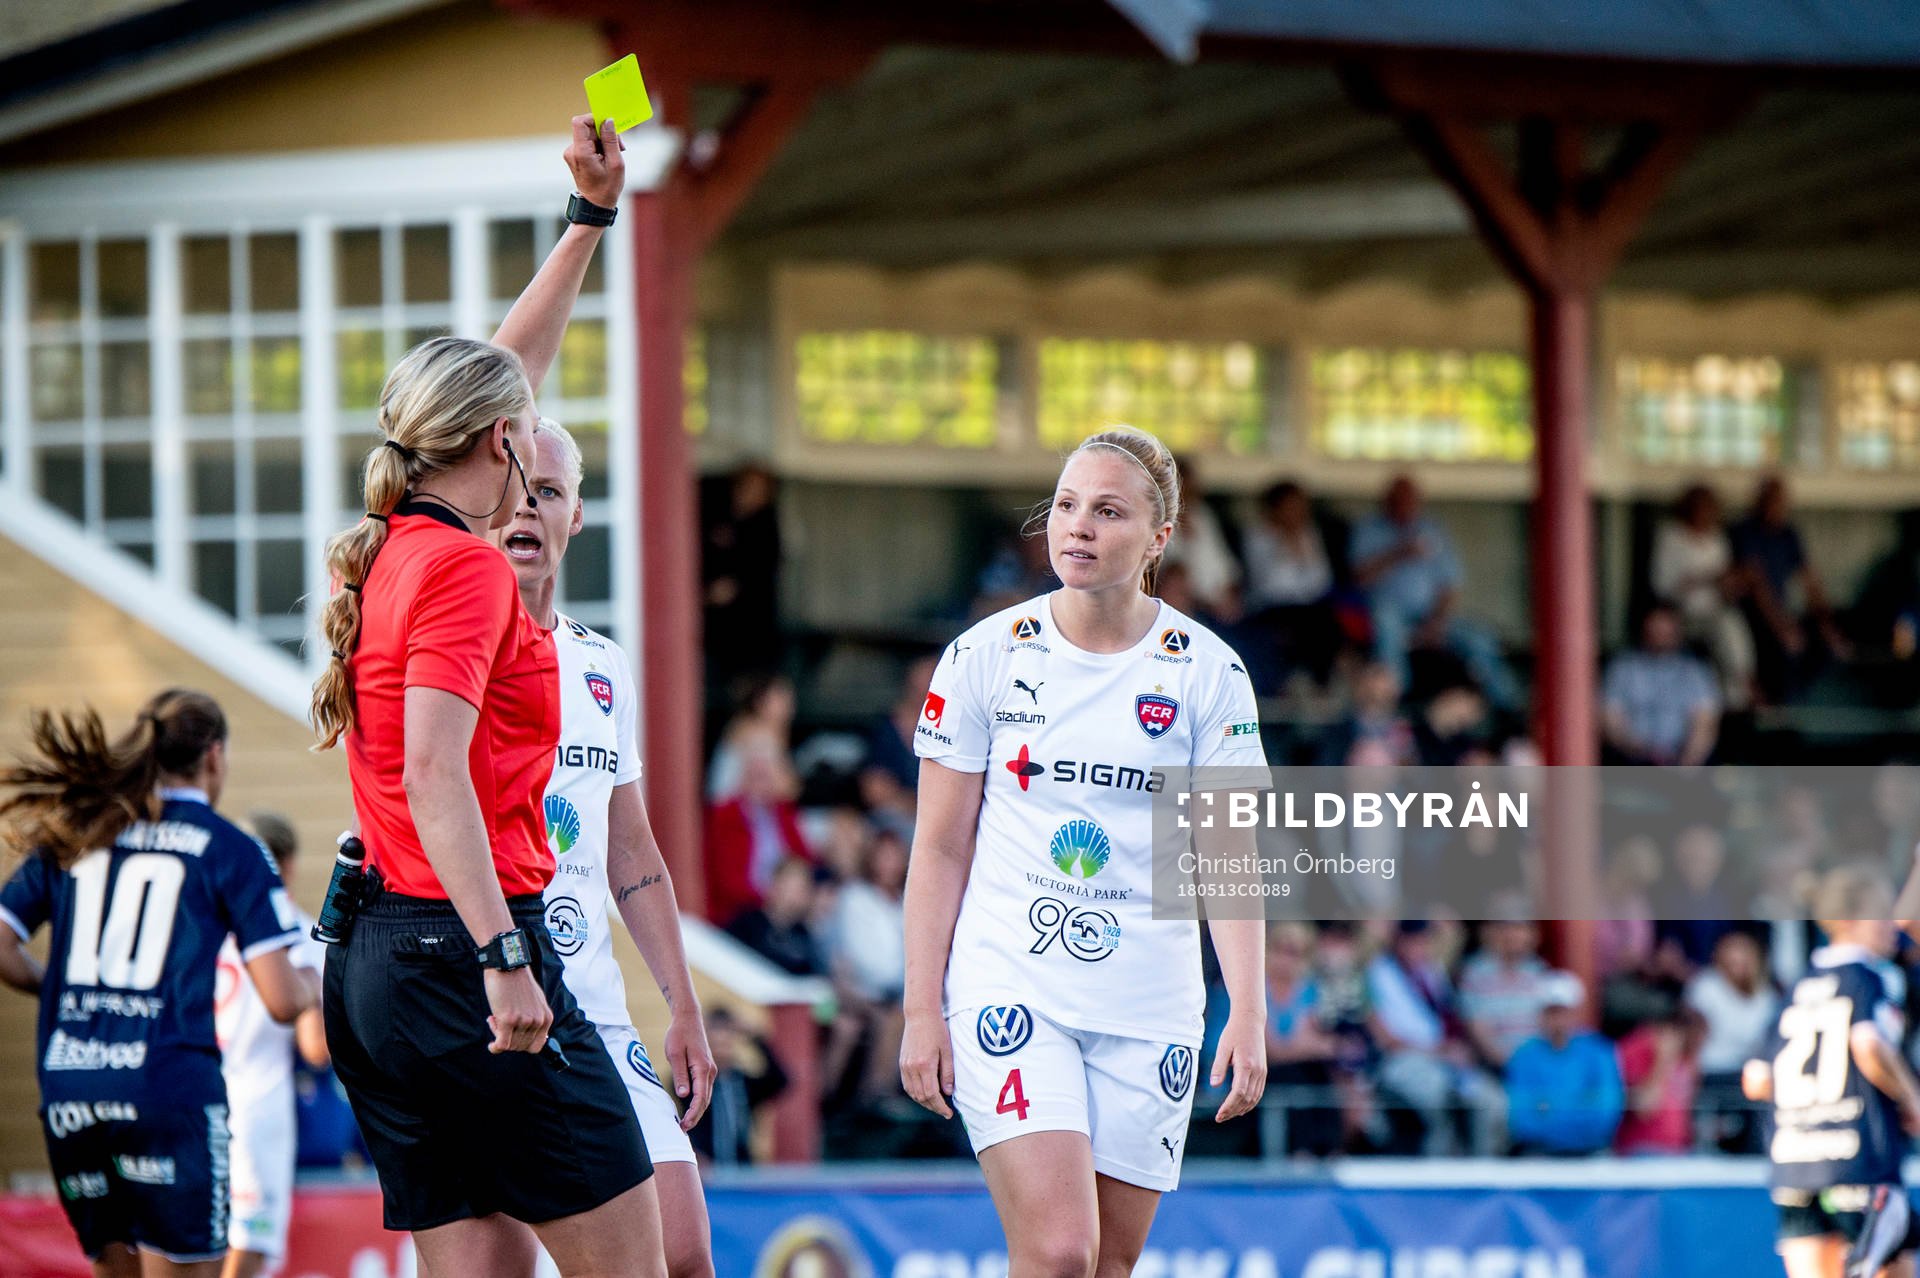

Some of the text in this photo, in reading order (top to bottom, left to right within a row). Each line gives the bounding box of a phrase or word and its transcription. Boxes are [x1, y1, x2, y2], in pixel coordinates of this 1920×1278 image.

[591, 682, 611, 696] FCR
[995, 709, 1046, 725] stadium
[1140, 704, 1173, 719] FCR
[934, 732, 953, 745] SPEL
[1026, 872, 1128, 900] VICTORIA PARK
[66, 850, 186, 991] 10
[1102, 925, 1121, 938] 1928
[1101, 936, 1119, 949] 2018
[1773, 996, 1854, 1110] 27
[996, 1068, 1030, 1121] 4
